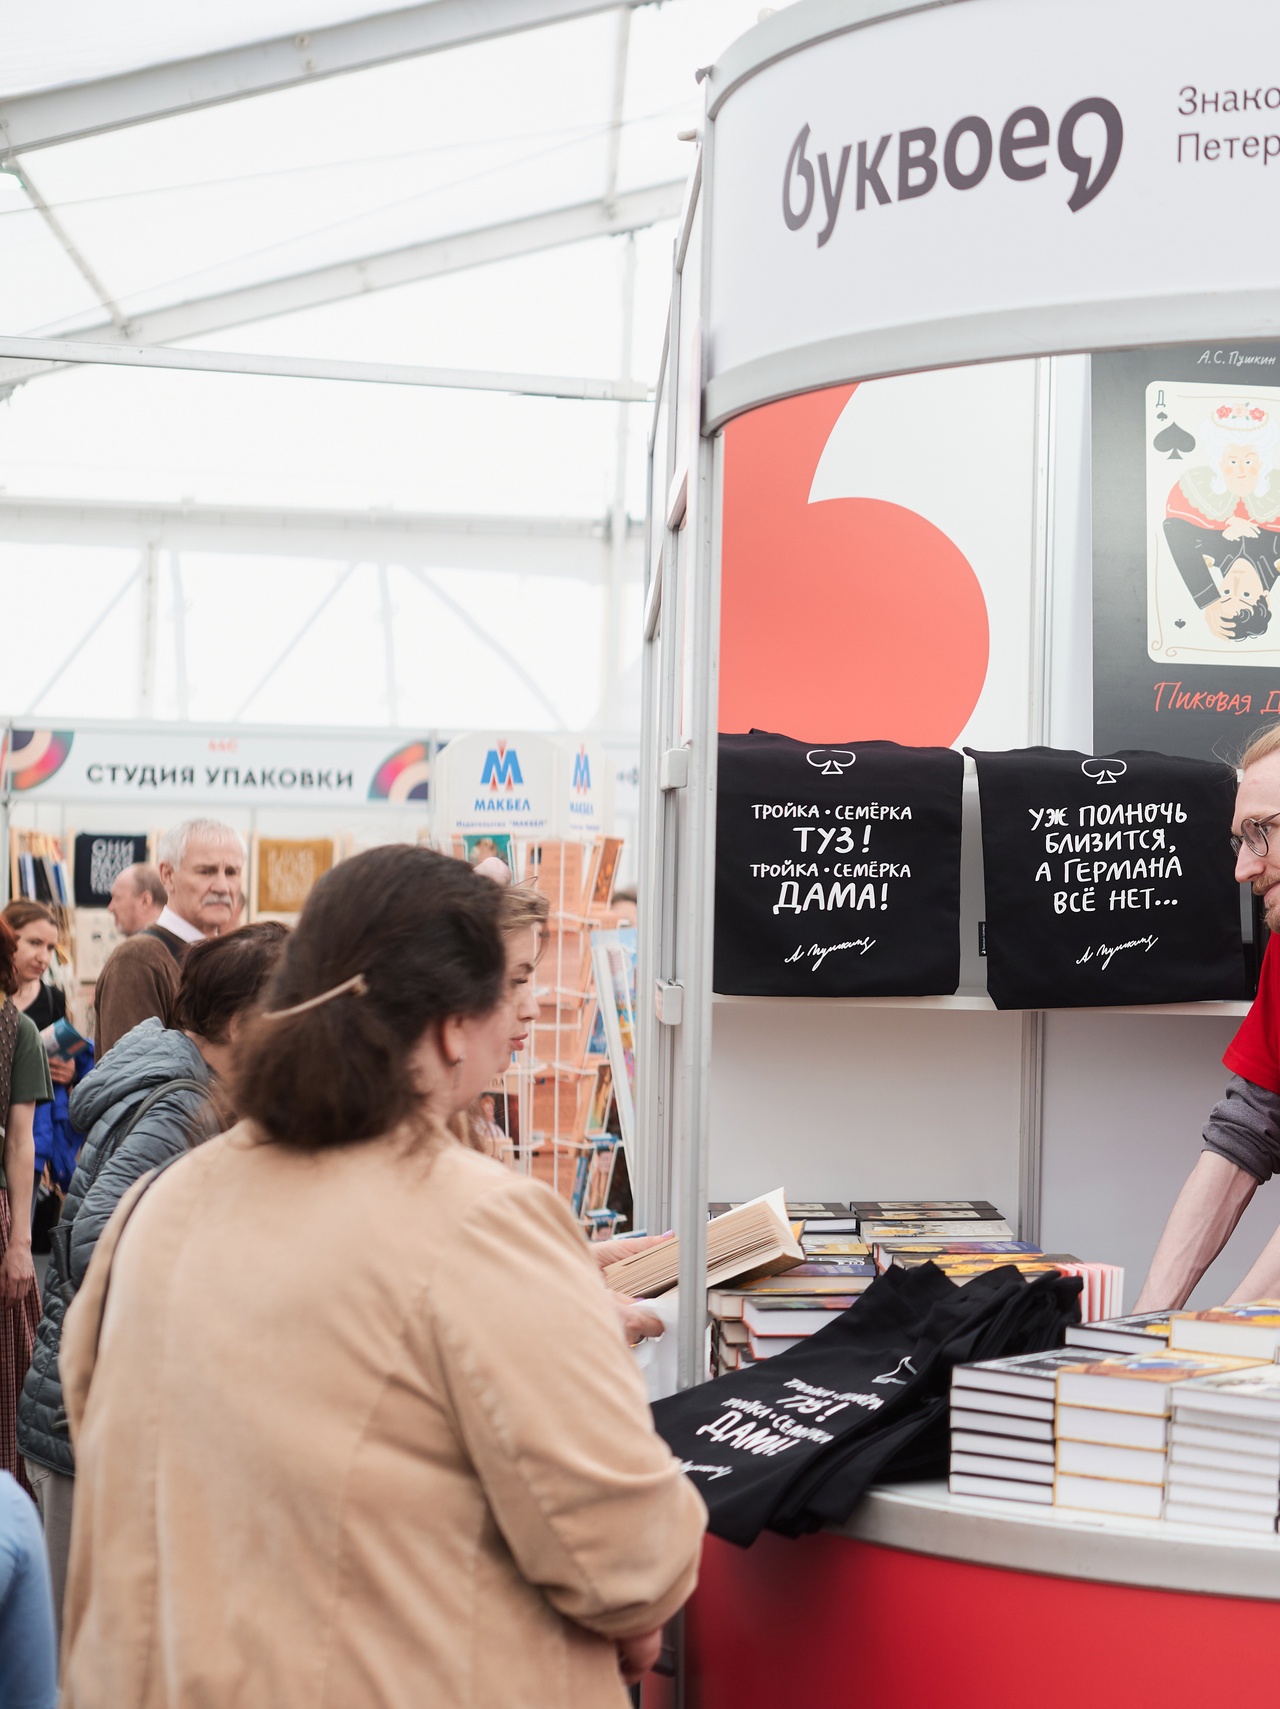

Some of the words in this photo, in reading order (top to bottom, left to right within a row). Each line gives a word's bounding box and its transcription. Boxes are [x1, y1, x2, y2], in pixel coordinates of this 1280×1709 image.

[781, 95, 1125, 249] буквоед
[87, 763, 197, 787] СТУДИЯ
[205, 765, 355, 792] УПАКОВКИ
[473, 798, 531, 812] МАКБЕЛ
[751, 801, 820, 821] ТРОЙКА
[834, 800, 913, 822] СЕМЁРКА
[1028, 806, 1068, 831] УЖ
[1078, 802, 1188, 828] ПОЛНОЧЬ
[1045, 828, 1177, 856] БЛИЗИТСЯ,
[749, 860, 819, 879] ТРОЙКА
[832, 861, 912, 880] СЕМЁРКА
[1034, 863, 1052, 882] А
[1063, 856, 1183, 883] ГЕРМАНА
[772, 881, 889, 916] ДАМА!
[1053, 886, 1097, 916] ВСЁ
[1108, 888, 1179, 912] НЕТ...
